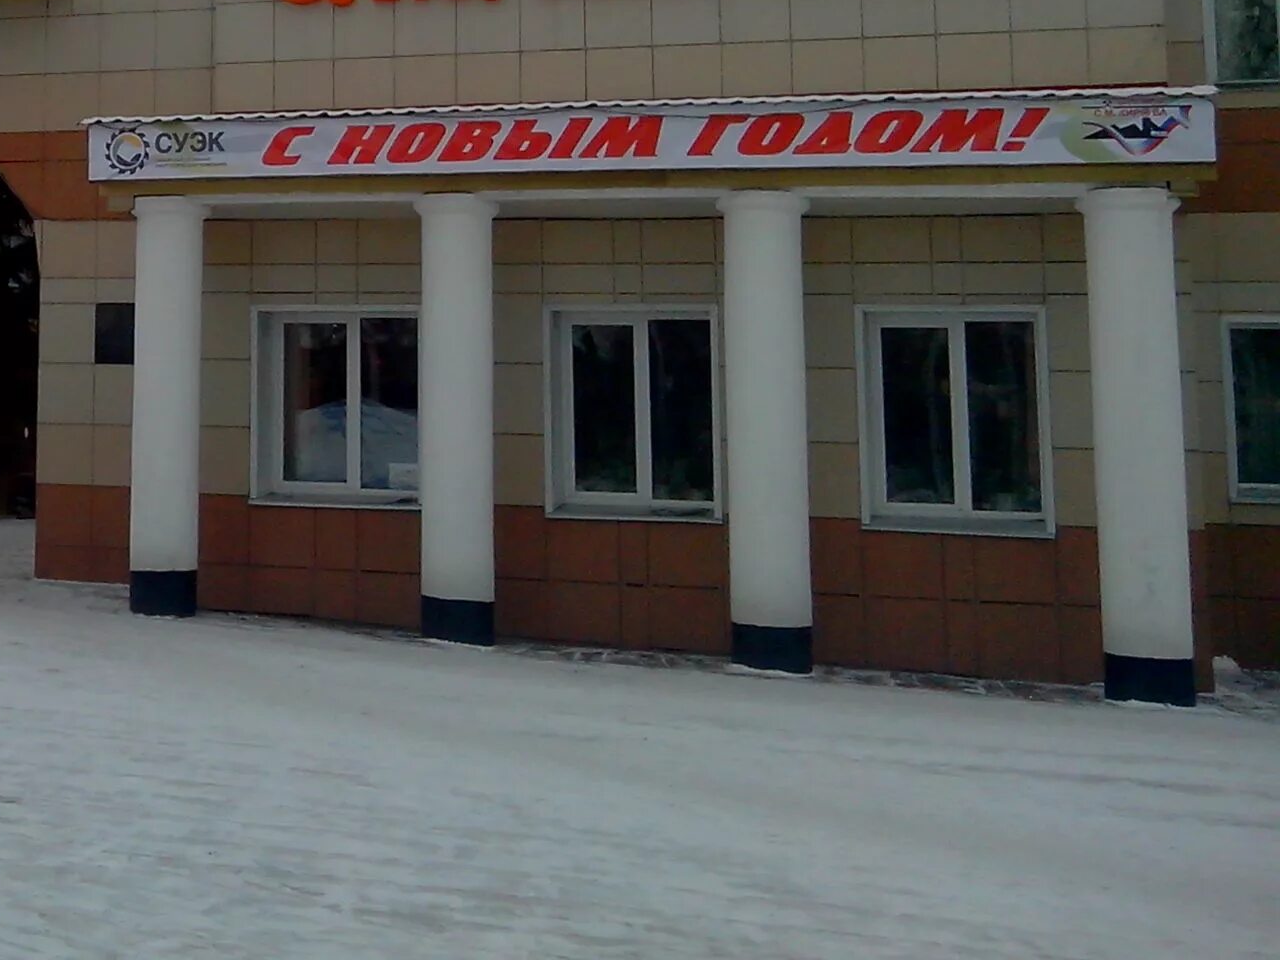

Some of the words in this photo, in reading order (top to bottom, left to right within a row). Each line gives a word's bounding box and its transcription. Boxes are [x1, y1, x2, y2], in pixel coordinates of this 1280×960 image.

[154, 131, 225, 153] СУЭК
[262, 126, 316, 166] С
[326, 115, 664, 166] НОВЫМ
[687, 107, 1052, 156] ГОДОМ!
